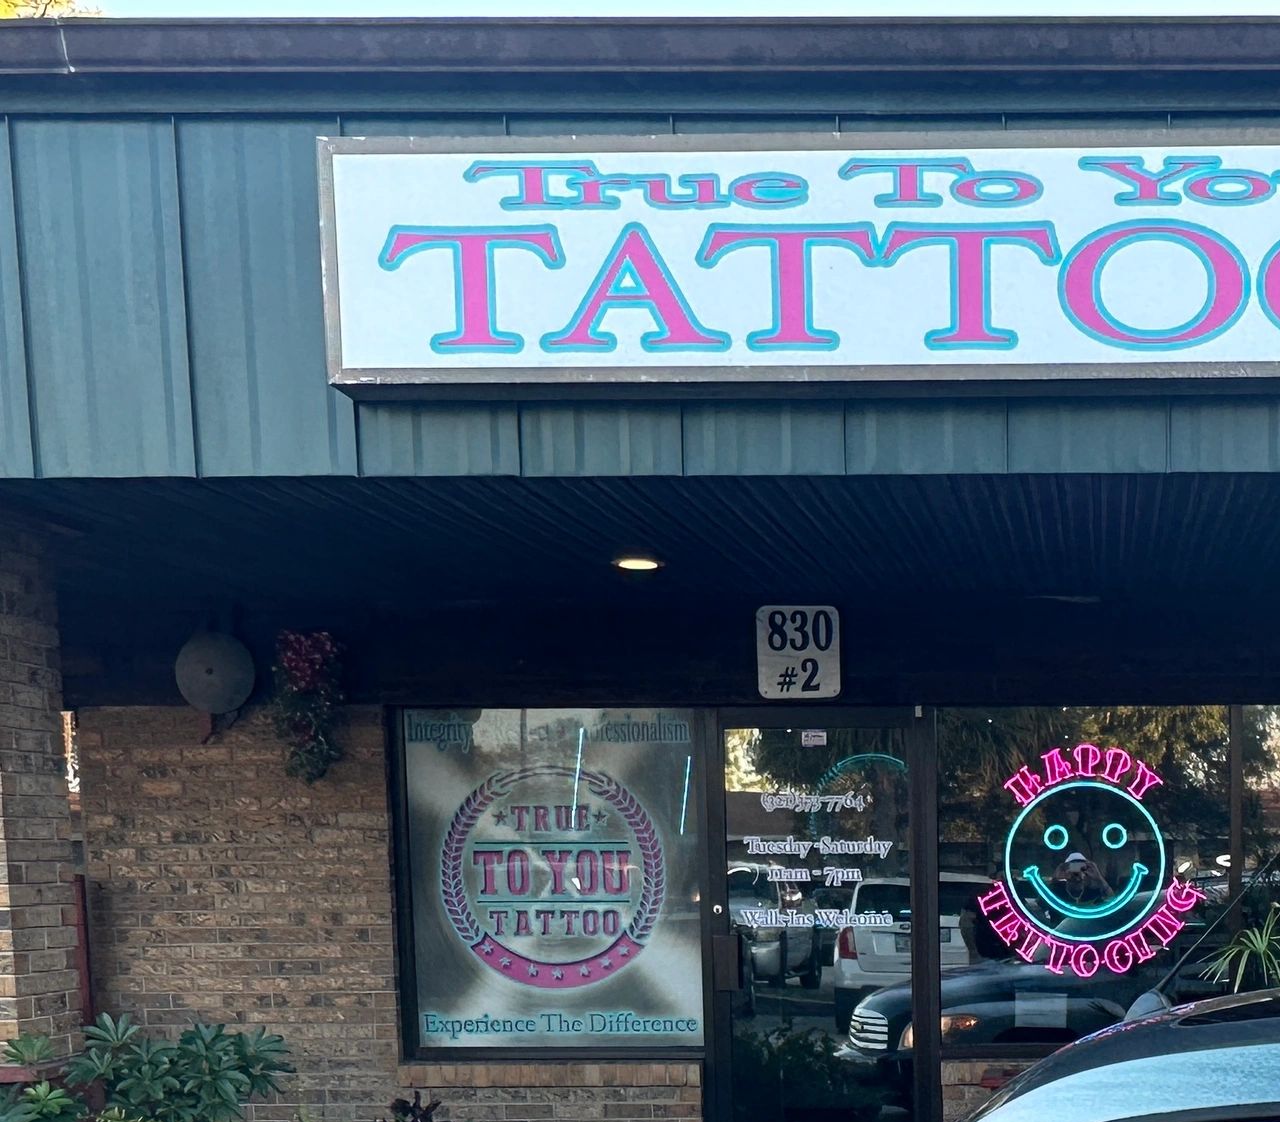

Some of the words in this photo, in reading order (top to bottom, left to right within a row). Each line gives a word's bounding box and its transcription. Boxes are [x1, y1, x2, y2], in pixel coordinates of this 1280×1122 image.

[464, 158, 811, 211] True
[838, 155, 1043, 208] To
[767, 609, 833, 652] 830
[776, 657, 820, 693] #2
[406, 713, 472, 754] Integrity
[1004, 744, 1164, 807] HAPPY
[509, 805, 592, 833] TRUE
[743, 836, 813, 859] Tuesday
[820, 836, 893, 859] Saturday
[473, 850, 532, 897] TO
[542, 850, 631, 898] YOU
[823, 867, 863, 886] 7pm
[488, 910, 621, 937] TATTOO
[741, 908, 815, 928] Walk-Ins
[815, 908, 893, 928] Welcome
[977, 876, 1207, 978] TATTOOING
[424, 1012, 536, 1038] Experience
[541, 1012, 584, 1033] The
[589, 1012, 698, 1034] Difference
